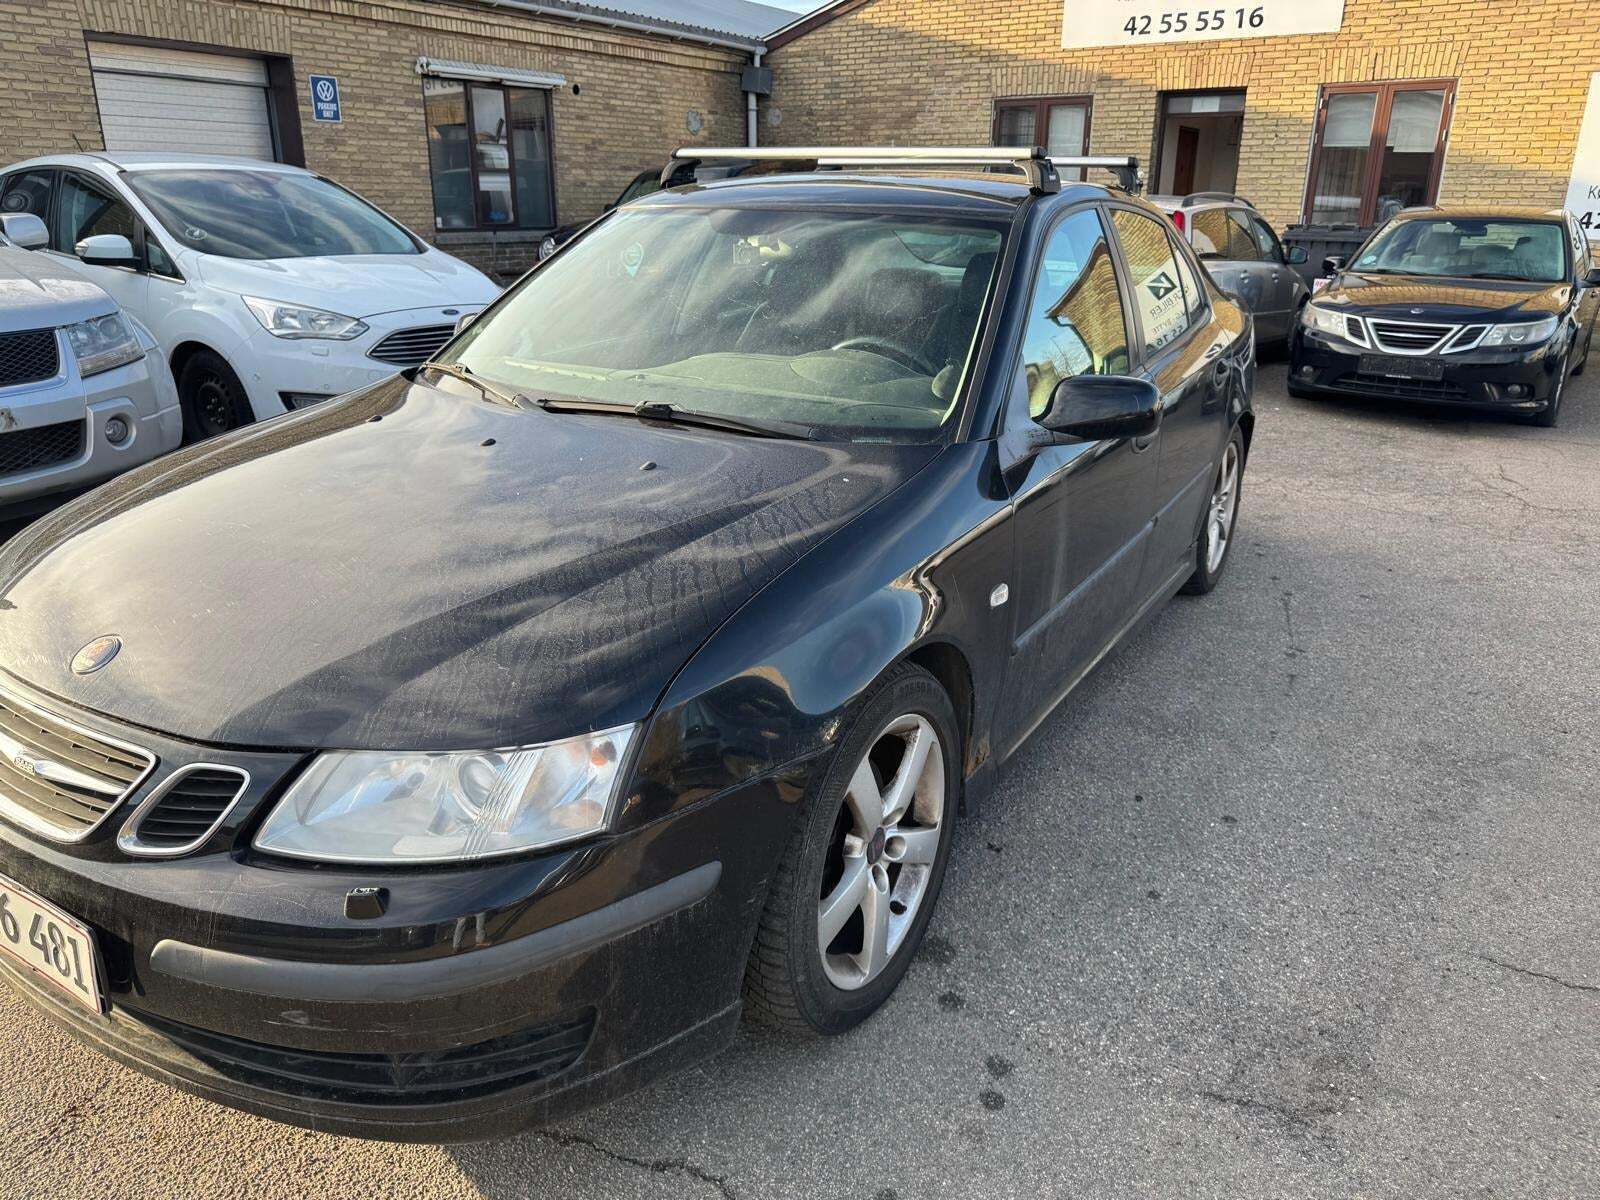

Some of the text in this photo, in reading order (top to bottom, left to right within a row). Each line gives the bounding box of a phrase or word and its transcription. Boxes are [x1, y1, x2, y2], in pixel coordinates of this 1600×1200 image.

[1123, 6, 1264, 36] 42 55 55 16
[29, 912, 90, 995] 481
